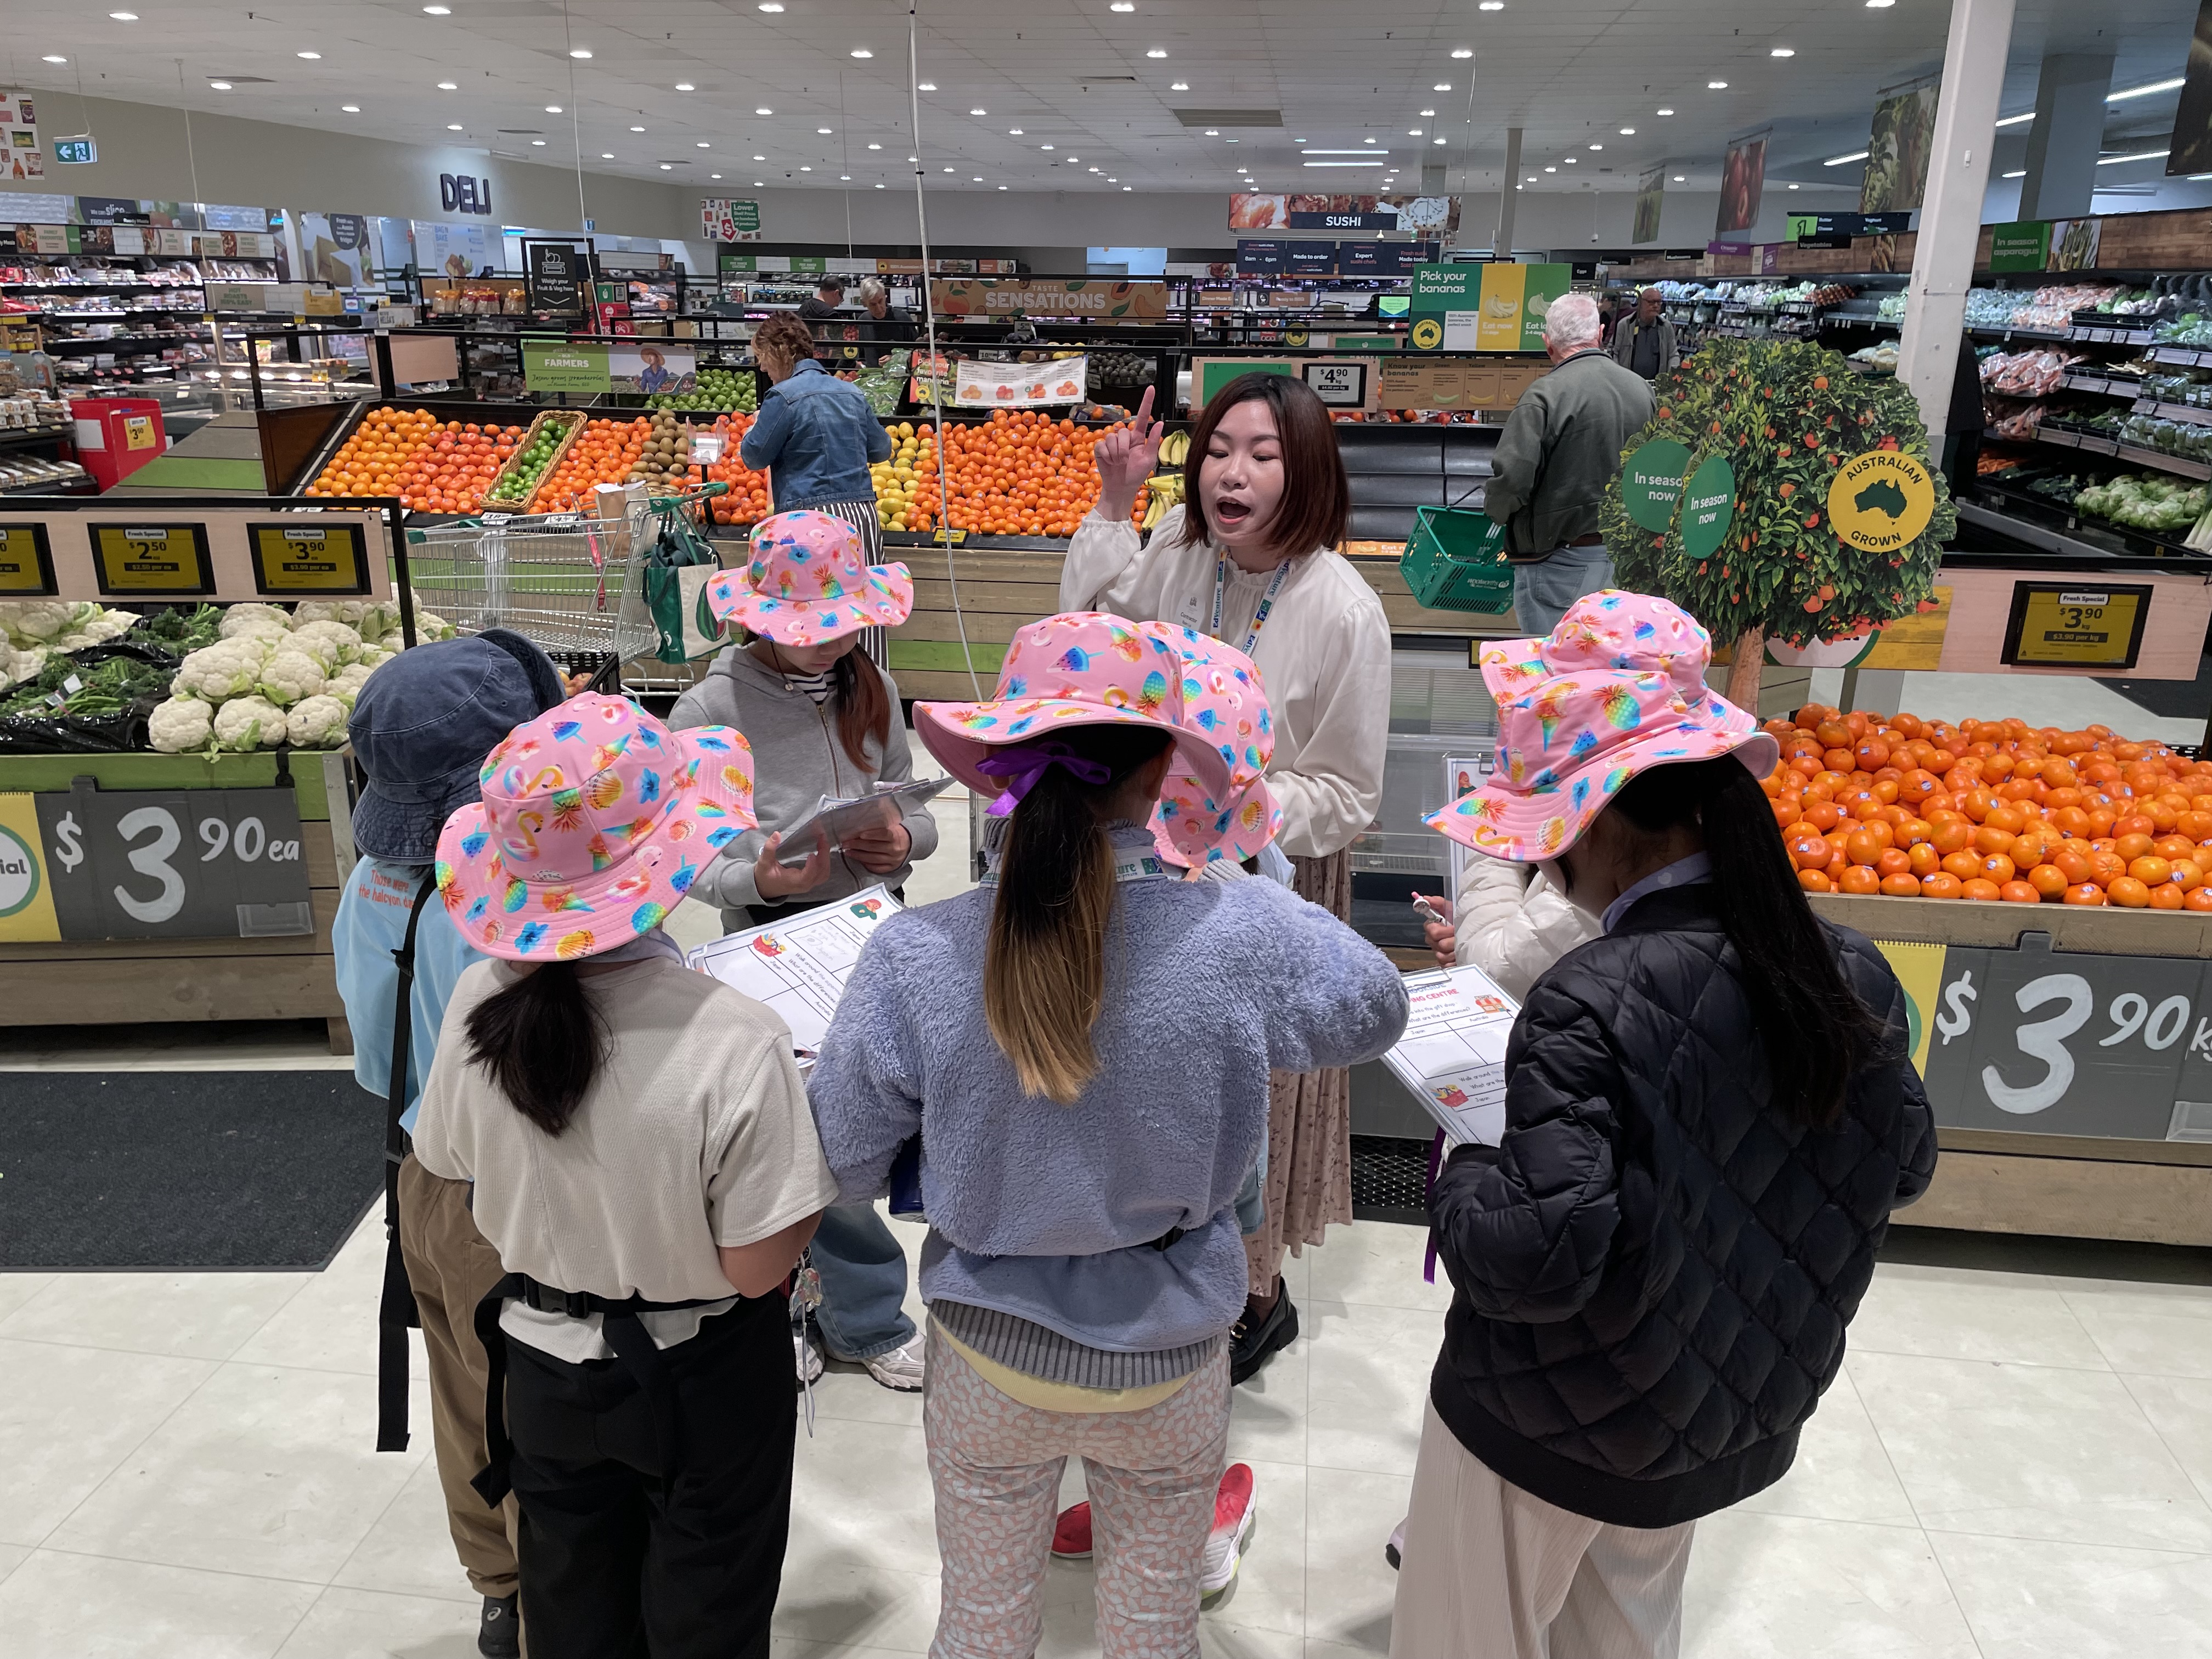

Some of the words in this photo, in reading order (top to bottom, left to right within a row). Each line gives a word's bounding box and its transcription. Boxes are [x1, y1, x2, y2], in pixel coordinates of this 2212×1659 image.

[440, 173, 492, 215] DELI
[1325, 216, 1362, 227] SUSHI
[1797, 219, 1807, 236] 1
[724, 223, 732, 235] $
[1994, 249, 2039, 257] asparagus
[1420, 270, 1442, 281] Pick
[1443, 273, 1466, 283] your
[1419, 284, 1465, 293] bananas
[985, 292, 1105, 309] SENSATIONS
[1418, 321, 1438, 329] AUSTRALIAN
[544, 358, 589, 368] FARMERS
[917, 368, 947, 377] favorite
[550, 375, 566, 383] grows
[1846, 456, 1923, 484] AUSTRALIAN
[1635, 472, 1646, 484] In
[1649, 476, 1683, 487] seaso
[1649, 491, 1675, 501] now
[1691, 497, 1699, 510] In
[1700, 494, 1728, 508] season
[1699, 512, 1717, 525] now
[1851, 531, 1902, 546] GROWN
[371, 869, 391, 887] Those
[392, 879, 409, 893] were
[359, 883, 370, 899] the
[372, 887, 402, 907] halcyon
[1426, 989, 1460, 1000] CENTRE
[1441, 1006, 1471, 1017] differences?
